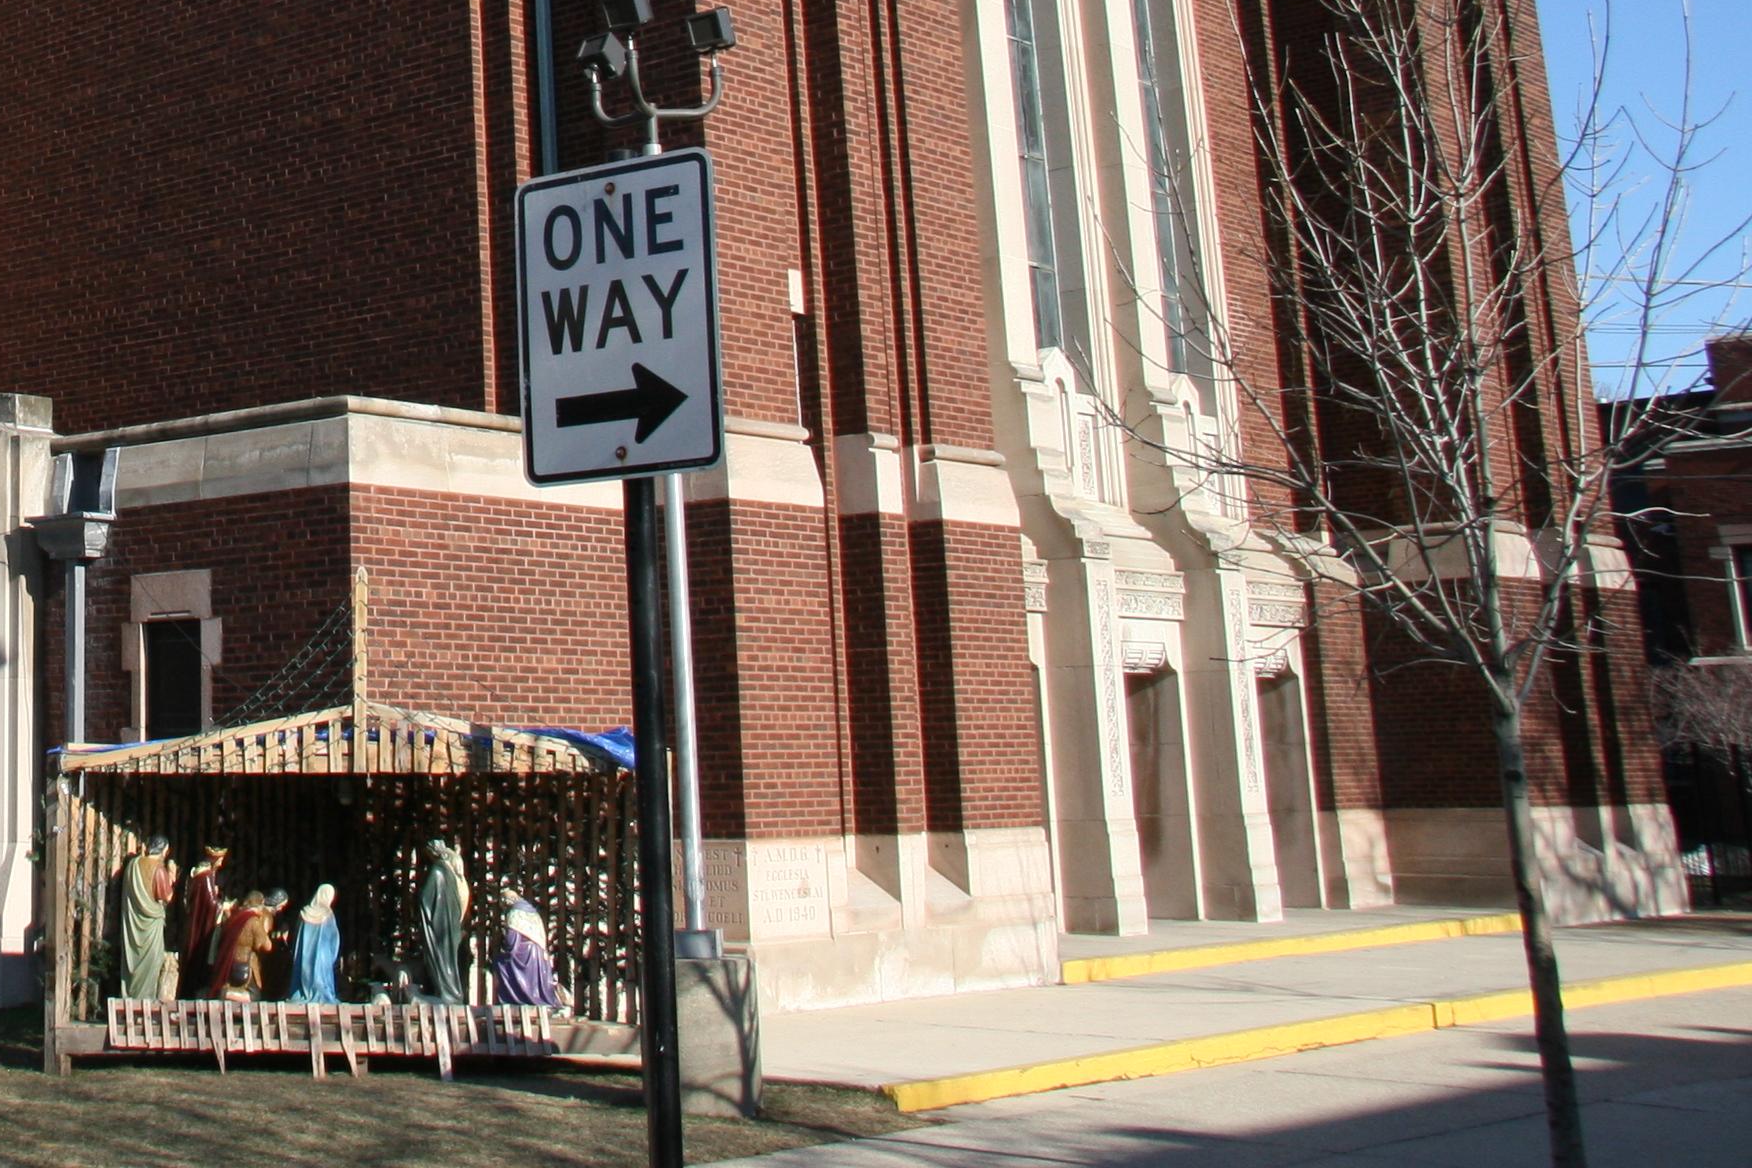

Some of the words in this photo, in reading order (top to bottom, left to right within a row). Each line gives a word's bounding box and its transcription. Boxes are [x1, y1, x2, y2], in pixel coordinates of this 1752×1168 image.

[543, 184, 685, 272] ONE
[541, 268, 690, 355] WAY
[706, 879, 739, 892] OMUS
